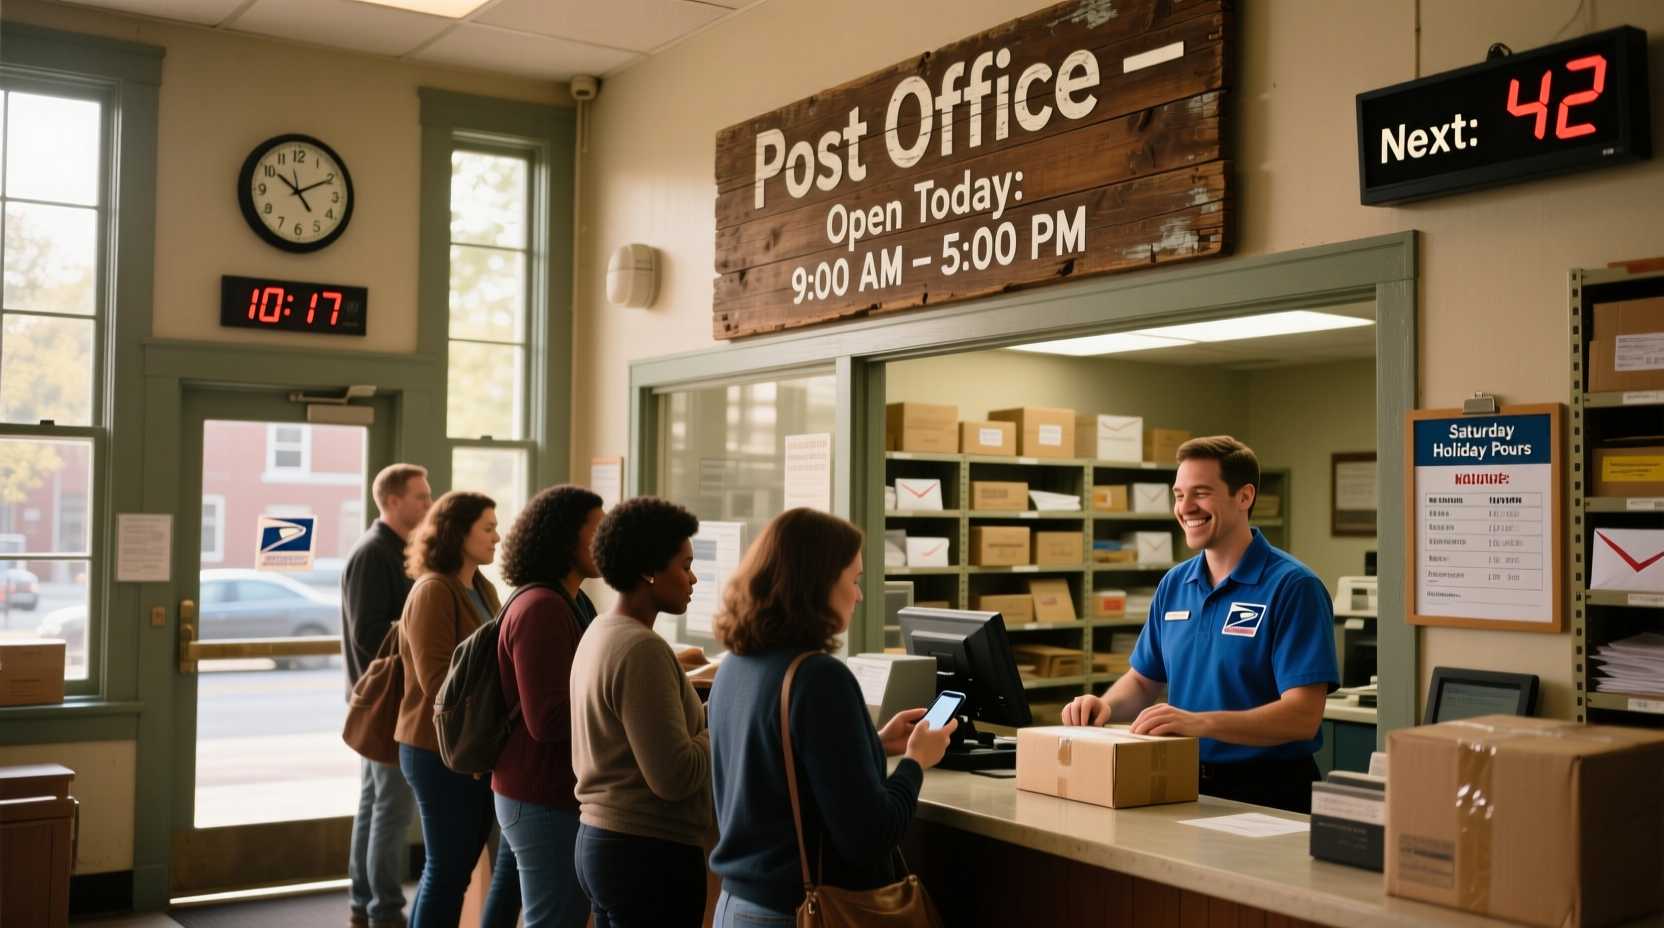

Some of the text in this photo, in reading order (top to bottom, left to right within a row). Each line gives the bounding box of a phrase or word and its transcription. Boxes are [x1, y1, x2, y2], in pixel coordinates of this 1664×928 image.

[1381, 54, 1607, 164] Next: 42
[754, 106, 867, 210] Post
[884, 47, 1100, 169] Office
[293, 149, 306, 163] 12
[264, 165, 276, 178] 10
[258, 183, 267, 195] 9
[331, 192, 339, 204] 3
[264, 203, 273, 214] 8
[325, 208, 333, 219] 4
[826, 169, 1024, 252] Open Today:
[278, 216, 285, 229] 7
[313, 220, 321, 233] 5
[294, 223, 302, 236] 6
[791, 257, 850, 305] 9:00
[858, 245, 903, 293] AM
[940, 221, 1017, 276] 5:00
[1031, 205, 1086, 260] PM
[248, 287, 342, 325] 10:17
[1448, 422, 1515, 441] Saturday
[1433, 441, 1532, 461] Holiday Pours
